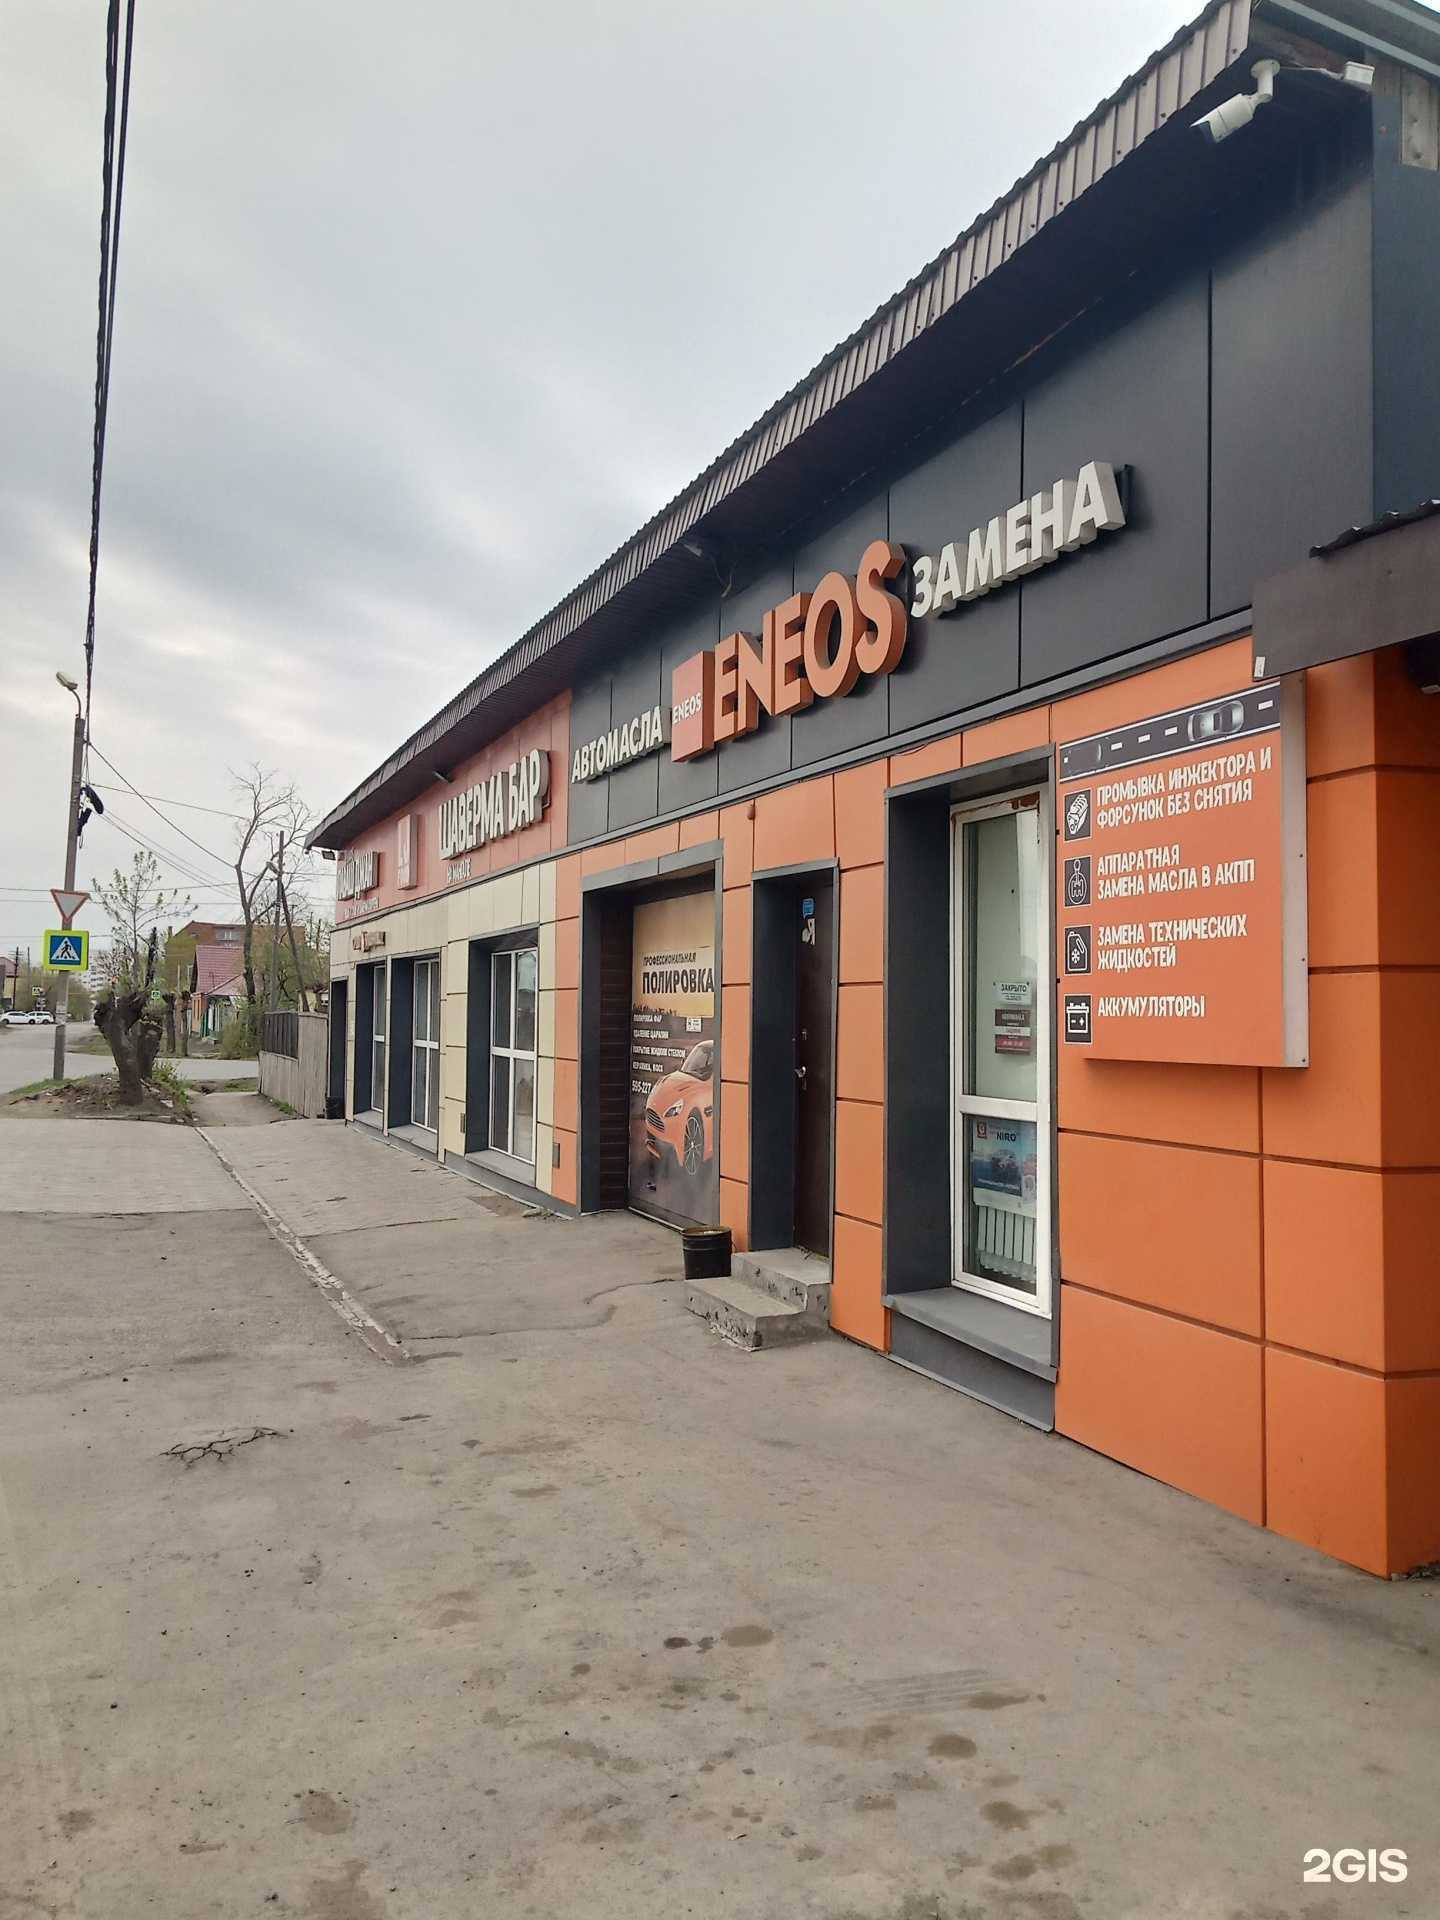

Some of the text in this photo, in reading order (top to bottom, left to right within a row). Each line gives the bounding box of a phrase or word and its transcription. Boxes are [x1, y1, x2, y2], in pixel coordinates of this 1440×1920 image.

[911, 460, 1122, 619] ЗАМЕНА
[714, 540, 906, 744] ENEOS
[672, 691, 702, 724] ENEOS
[571, 706, 664, 784] АВТОМАСЛА
[1097, 747, 1271, 806] ПРОМЫВКА ИНЖЕКТОРА И
[438, 749, 547, 860] ШАВЕРМА БАР
[1097, 778, 1252, 829] ФОРСУНОК БЕЗ СНЯТИЯ
[1097, 845, 1180, 876] АППАРАТНАЯ
[1097, 859, 1255, 900] ЗАМЕНА МАСЛА В АКПП
[1097, 914, 1248, 947] ЗАМЕНА ТЕХНИЧЕСКИХ
[643, 953, 696, 966] ПРОФЕССИОНАЛЬНАЯ
[1097, 943, 1176, 973] ЖИДКОСТЕЙ
[642, 968, 714, 994] ПОЛИРОВКА
[1001, 984, 1027, 992] ЗАКРЫТО
[1098, 996, 1205, 1017] АККУМУЛЯТОРЫ
